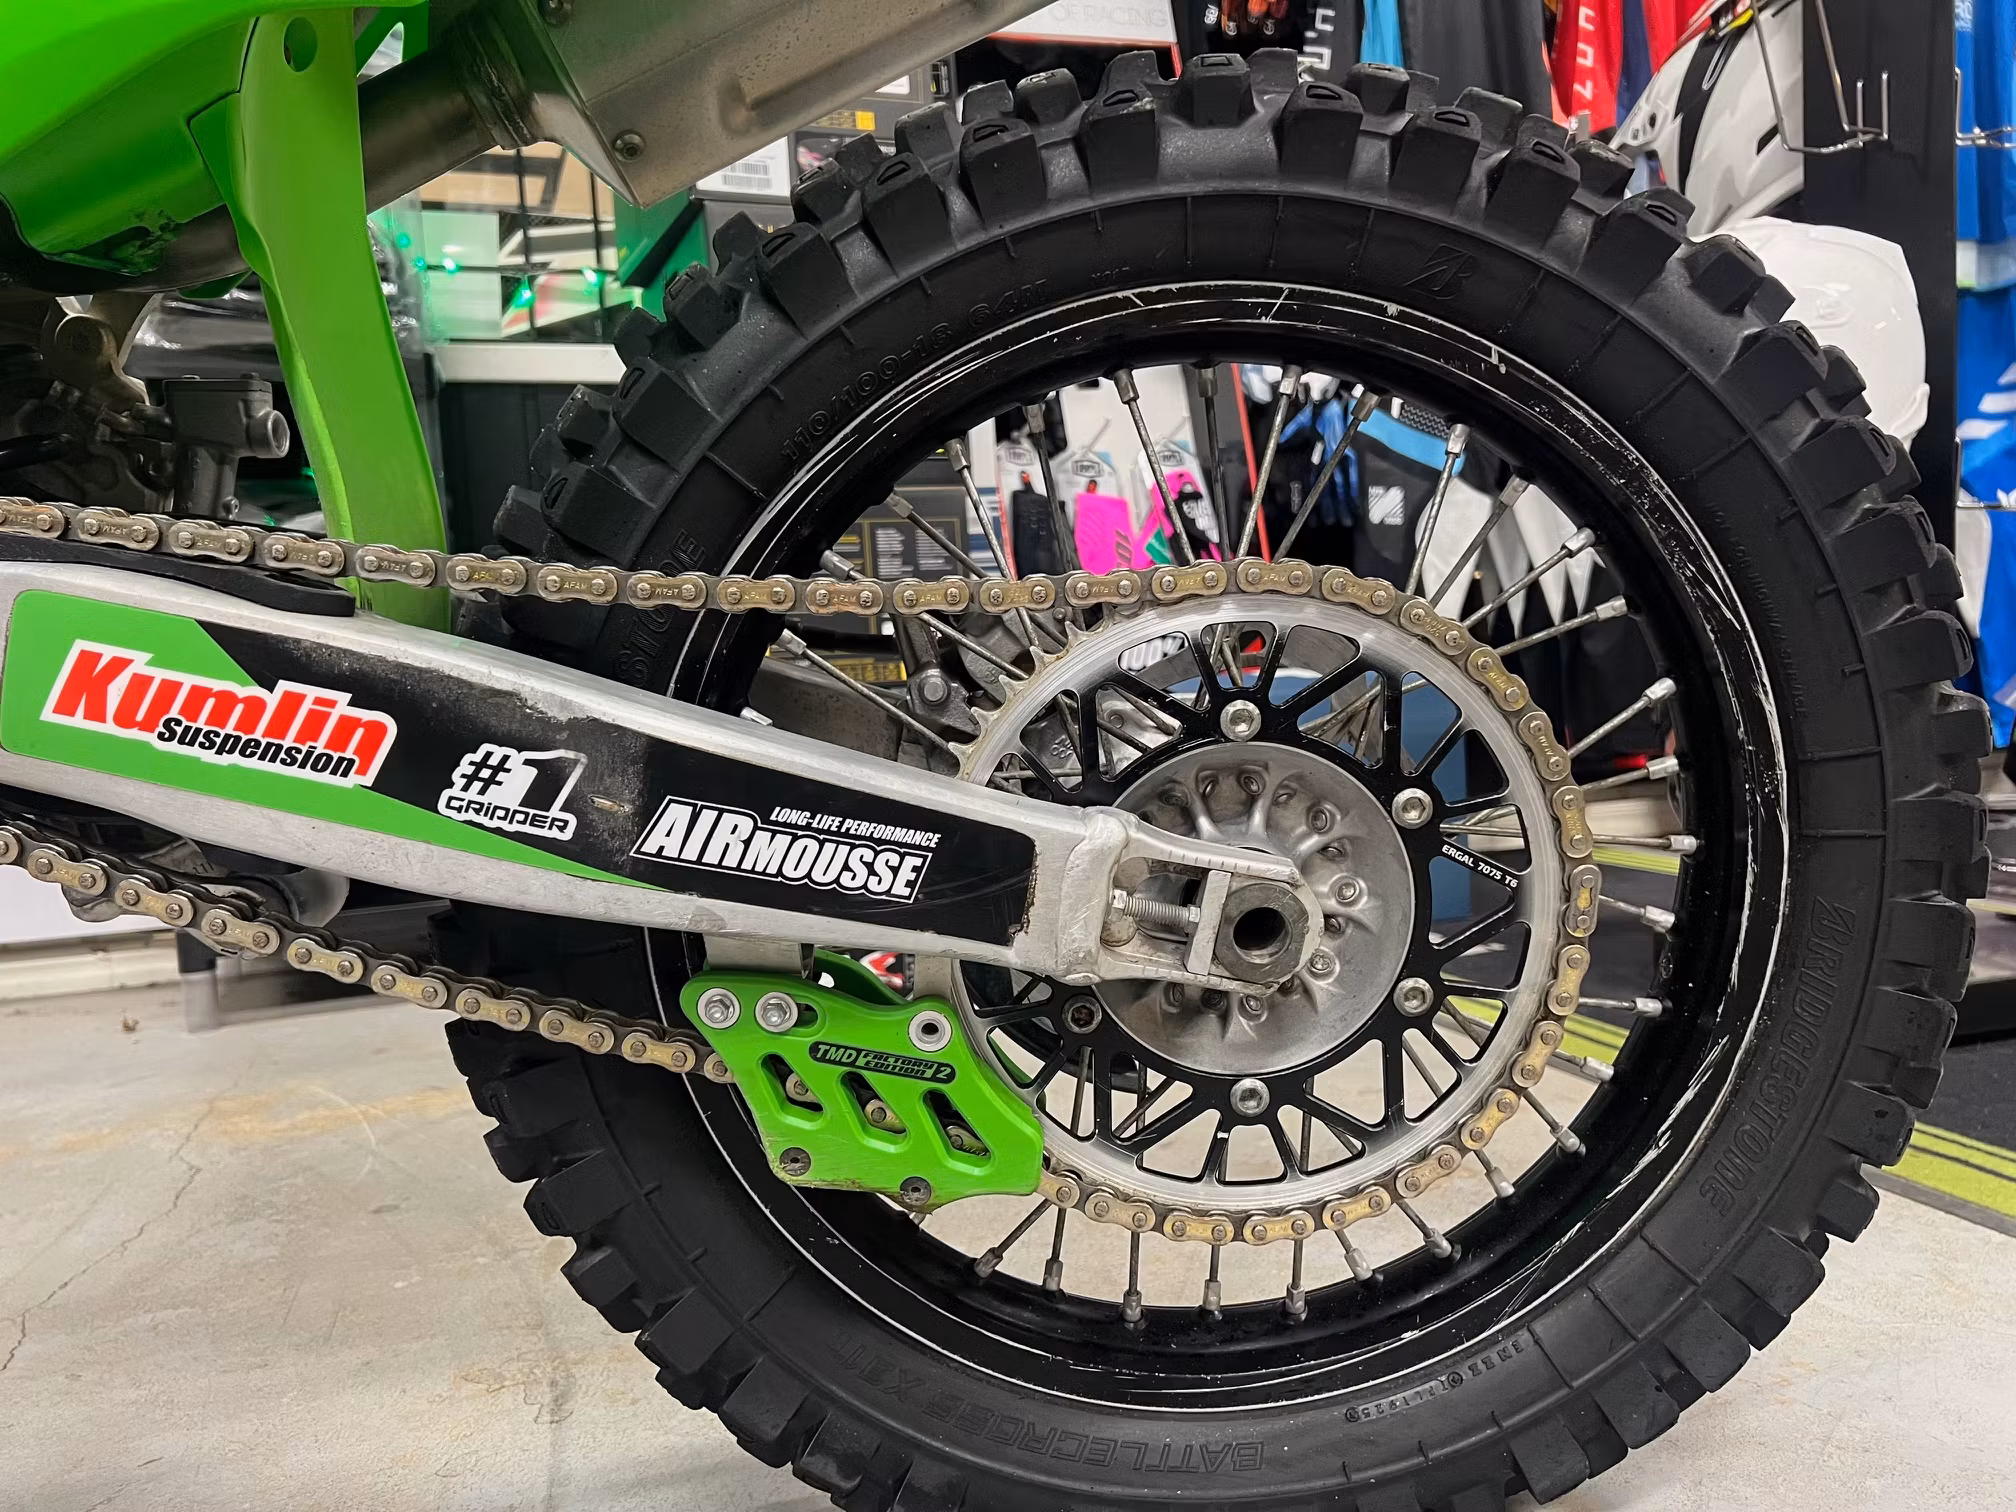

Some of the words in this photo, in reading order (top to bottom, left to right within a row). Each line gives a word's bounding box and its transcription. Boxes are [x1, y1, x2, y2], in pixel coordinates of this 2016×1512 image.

[562, 580, 588, 591] AFAM
[654, 587, 680, 597] AFAM
[52, 648, 389, 778] Kumlin
[156, 716, 357, 779] Suspension
[458, 750, 582, 813] #1
[769, 805, 843, 832] LONG-LIFE
[840, 817, 942, 849] PERFORMANCE
[1441, 844, 1475, 868] ERGAL
[1477, 861, 1504, 880] 7075
[1504, 875, 1519, 888] T6
[815, 1043, 858, 1064] TMD
[861, 1051, 936, 1071] FACTORY
[862, 1060, 928, 1077] EDITION
[935, 1065, 952, 1080] 2
[1697, 894, 1858, 1220] BRIDGESTONE
[921, 1392, 1266, 1473] BATTLECROSS
